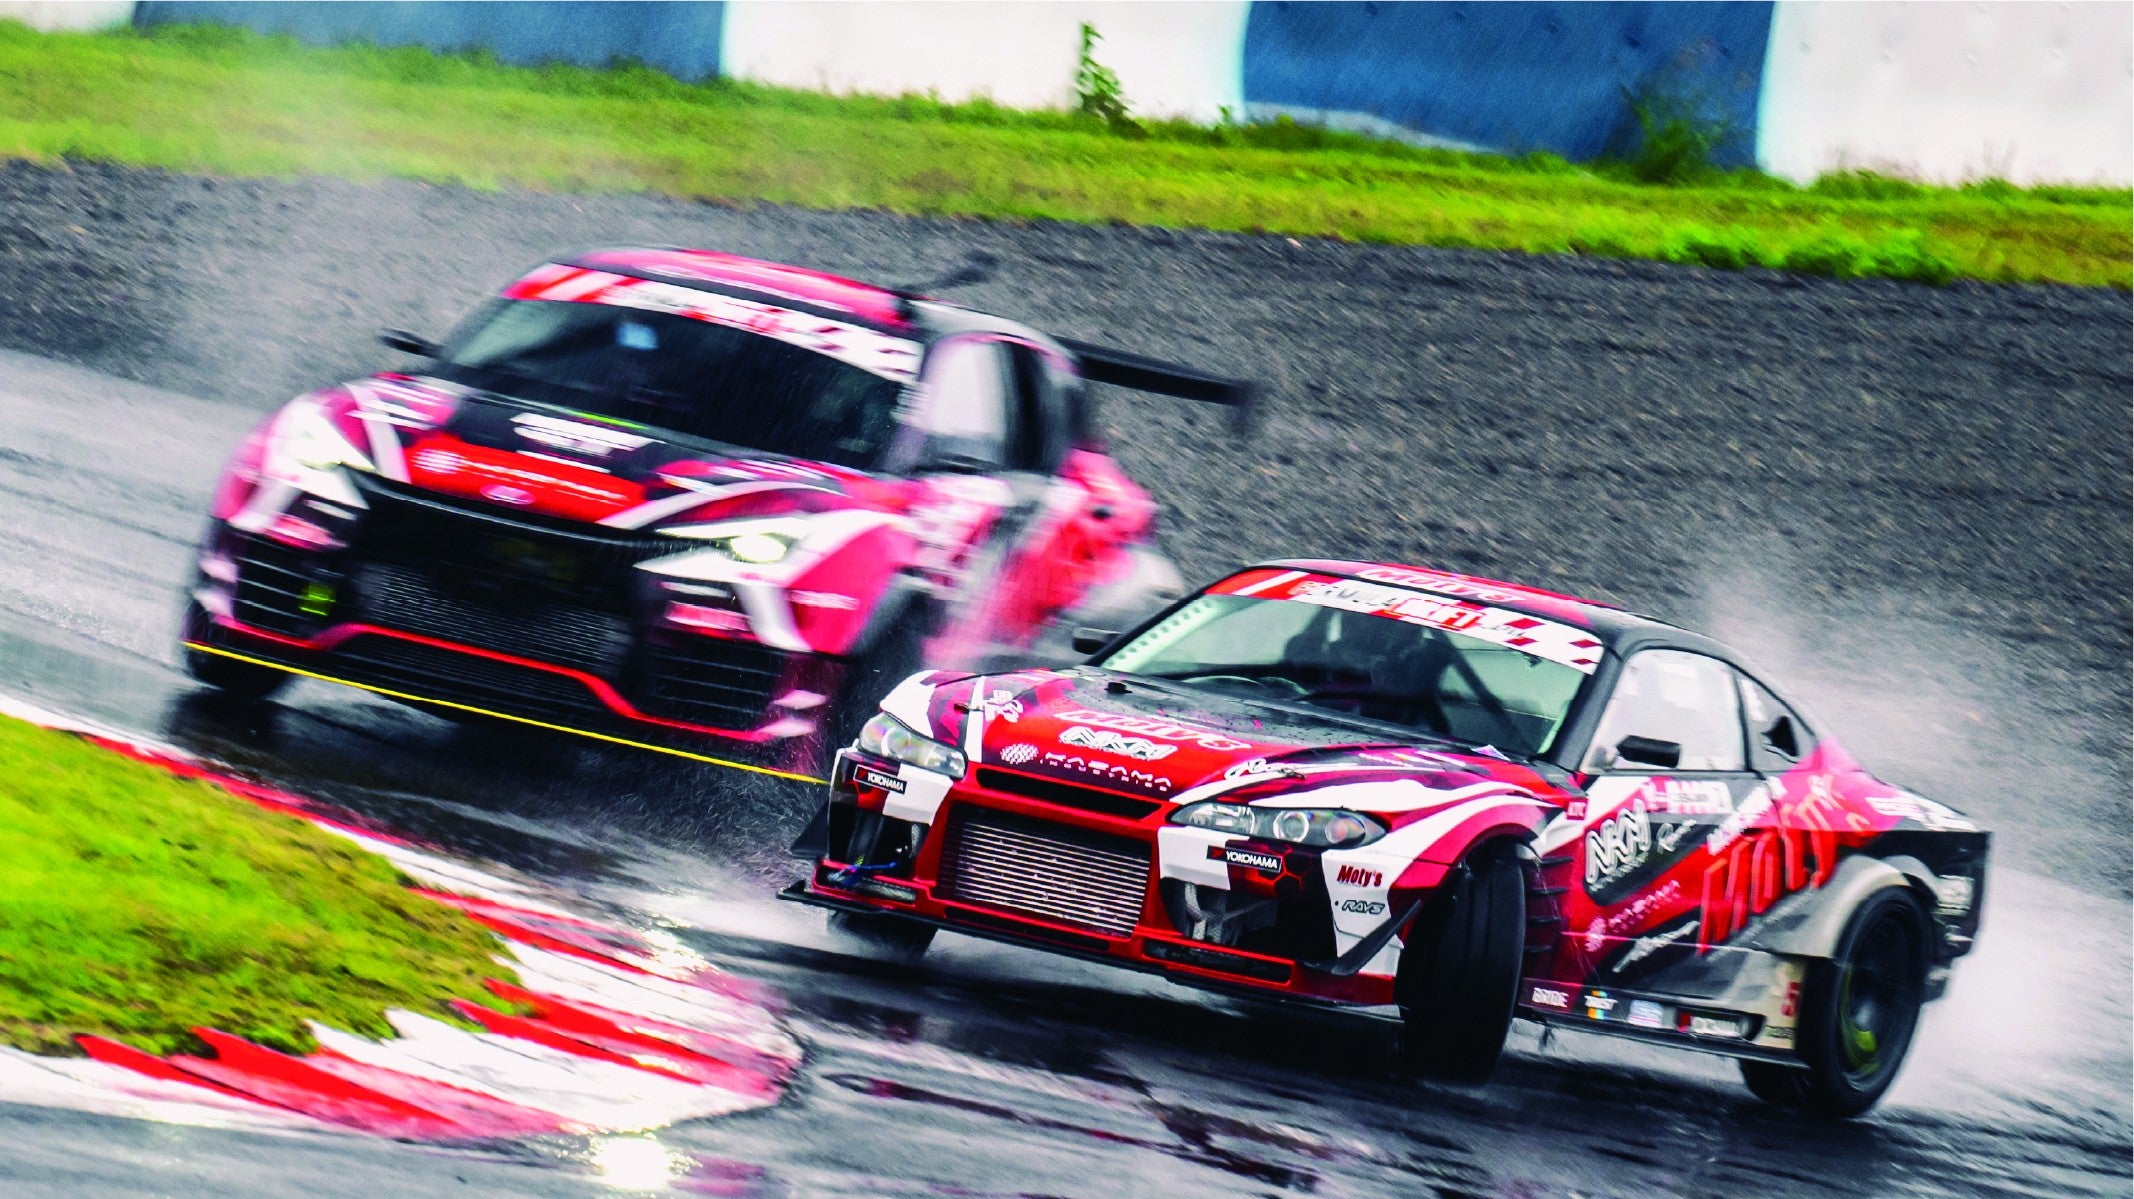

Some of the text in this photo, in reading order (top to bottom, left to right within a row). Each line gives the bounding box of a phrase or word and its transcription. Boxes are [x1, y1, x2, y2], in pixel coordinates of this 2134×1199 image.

[867, 771, 905, 792] YOKOHAMA
[1226, 850, 1278, 869] YOKOHAMA
[1336, 864, 1383, 888] Moty's
[1341, 899, 1386, 915] RAYS
